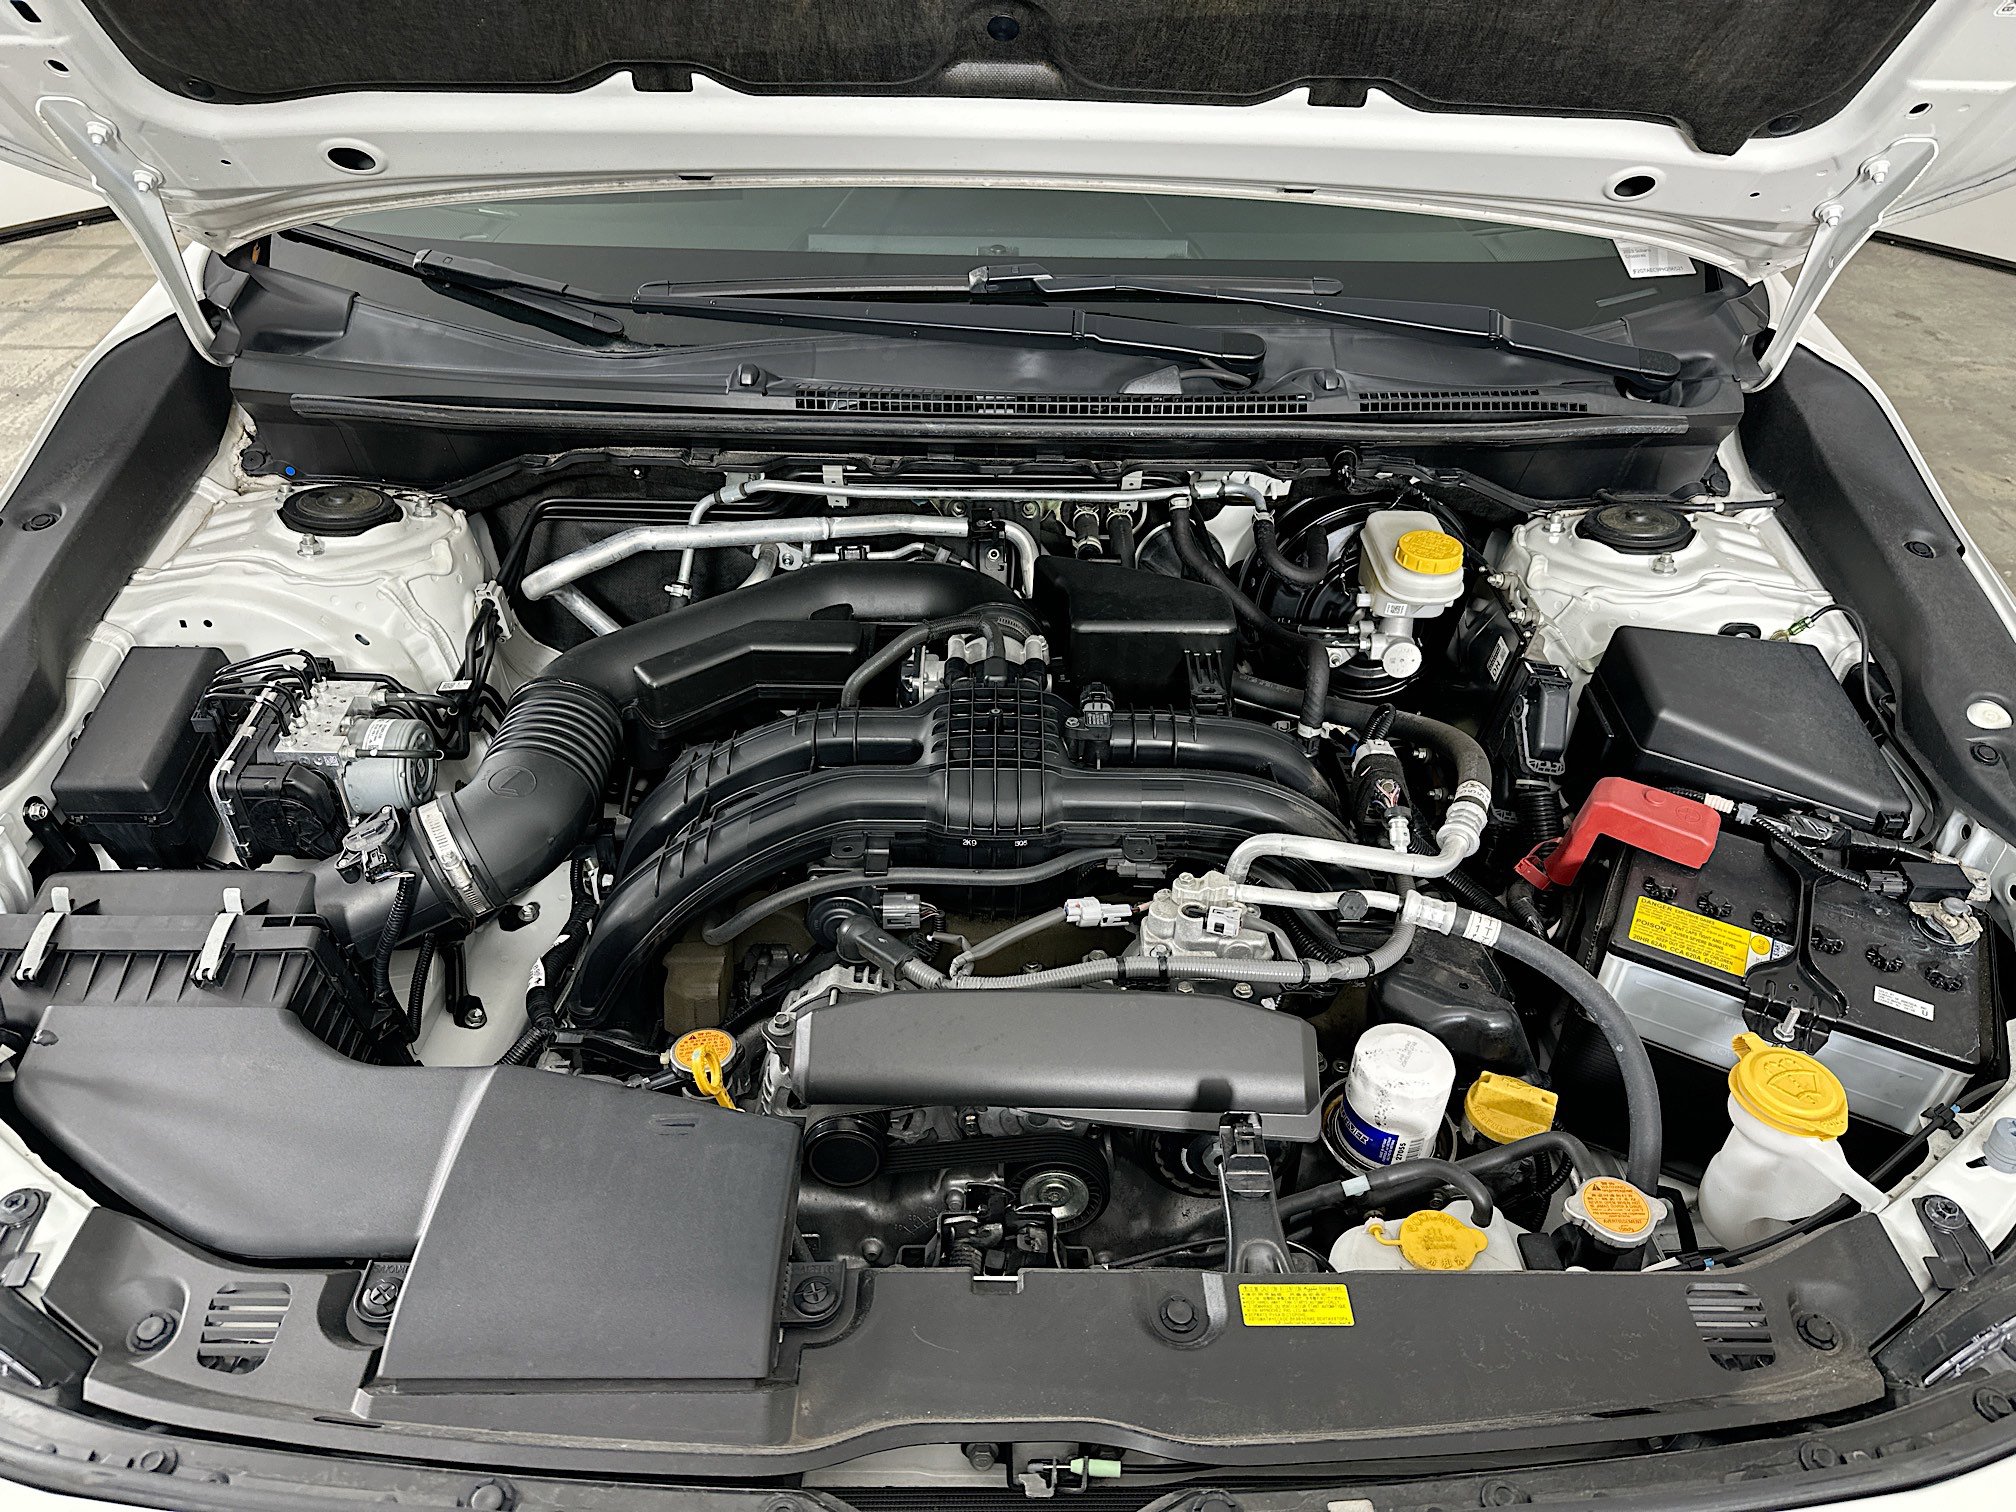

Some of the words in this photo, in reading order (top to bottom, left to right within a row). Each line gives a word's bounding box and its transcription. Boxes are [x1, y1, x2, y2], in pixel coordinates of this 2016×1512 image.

[1641, 898, 1672, 912] DANGER
[1636, 918, 1667, 932] POISON
[1633, 934, 1650, 943] 20HR
[1651, 939, 1667, 949] 62Ah
[1670, 947, 1684, 955] CCA
